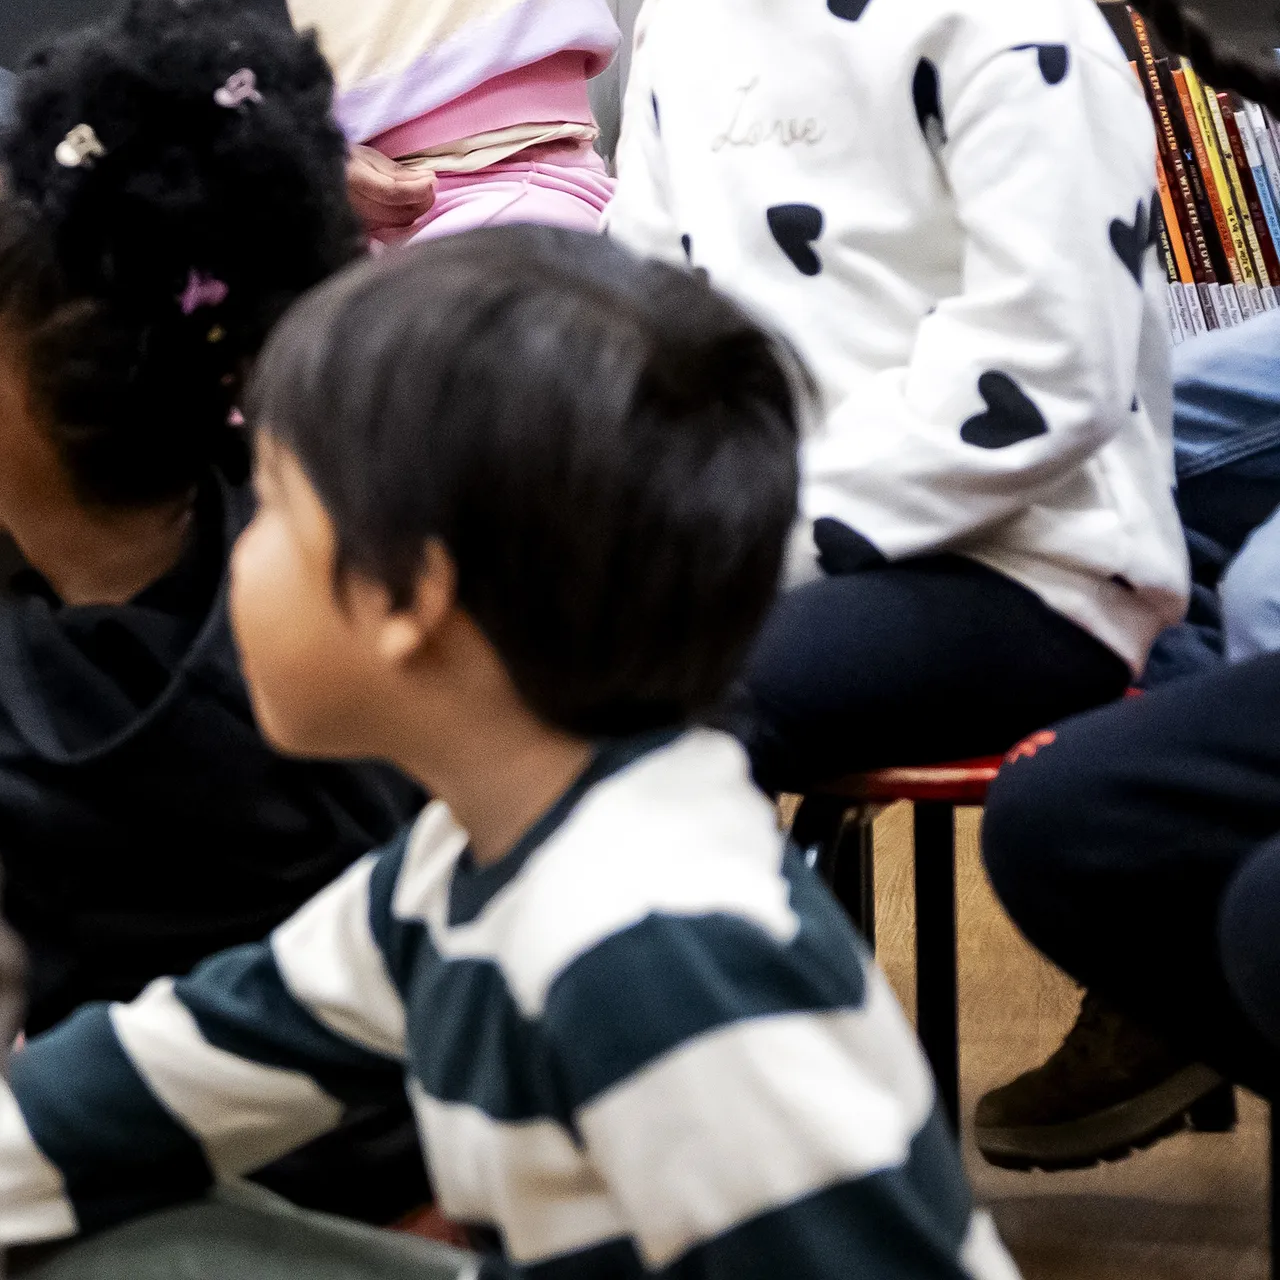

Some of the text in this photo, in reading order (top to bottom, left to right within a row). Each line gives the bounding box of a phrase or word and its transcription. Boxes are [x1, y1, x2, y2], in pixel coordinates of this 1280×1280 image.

[711, 75, 827, 153] Love
[1134, 19, 1146, 41] VAN
[1141, 45, 1152, 65] DER
[1159, 106, 1177, 151] JANSSEN
[1175, 159, 1183, 171] IK
[1179, 176, 1189, 199] WIL
[1187, 203, 1198, 225] EEN
[1195, 229, 1212, 273] LEEUW!
